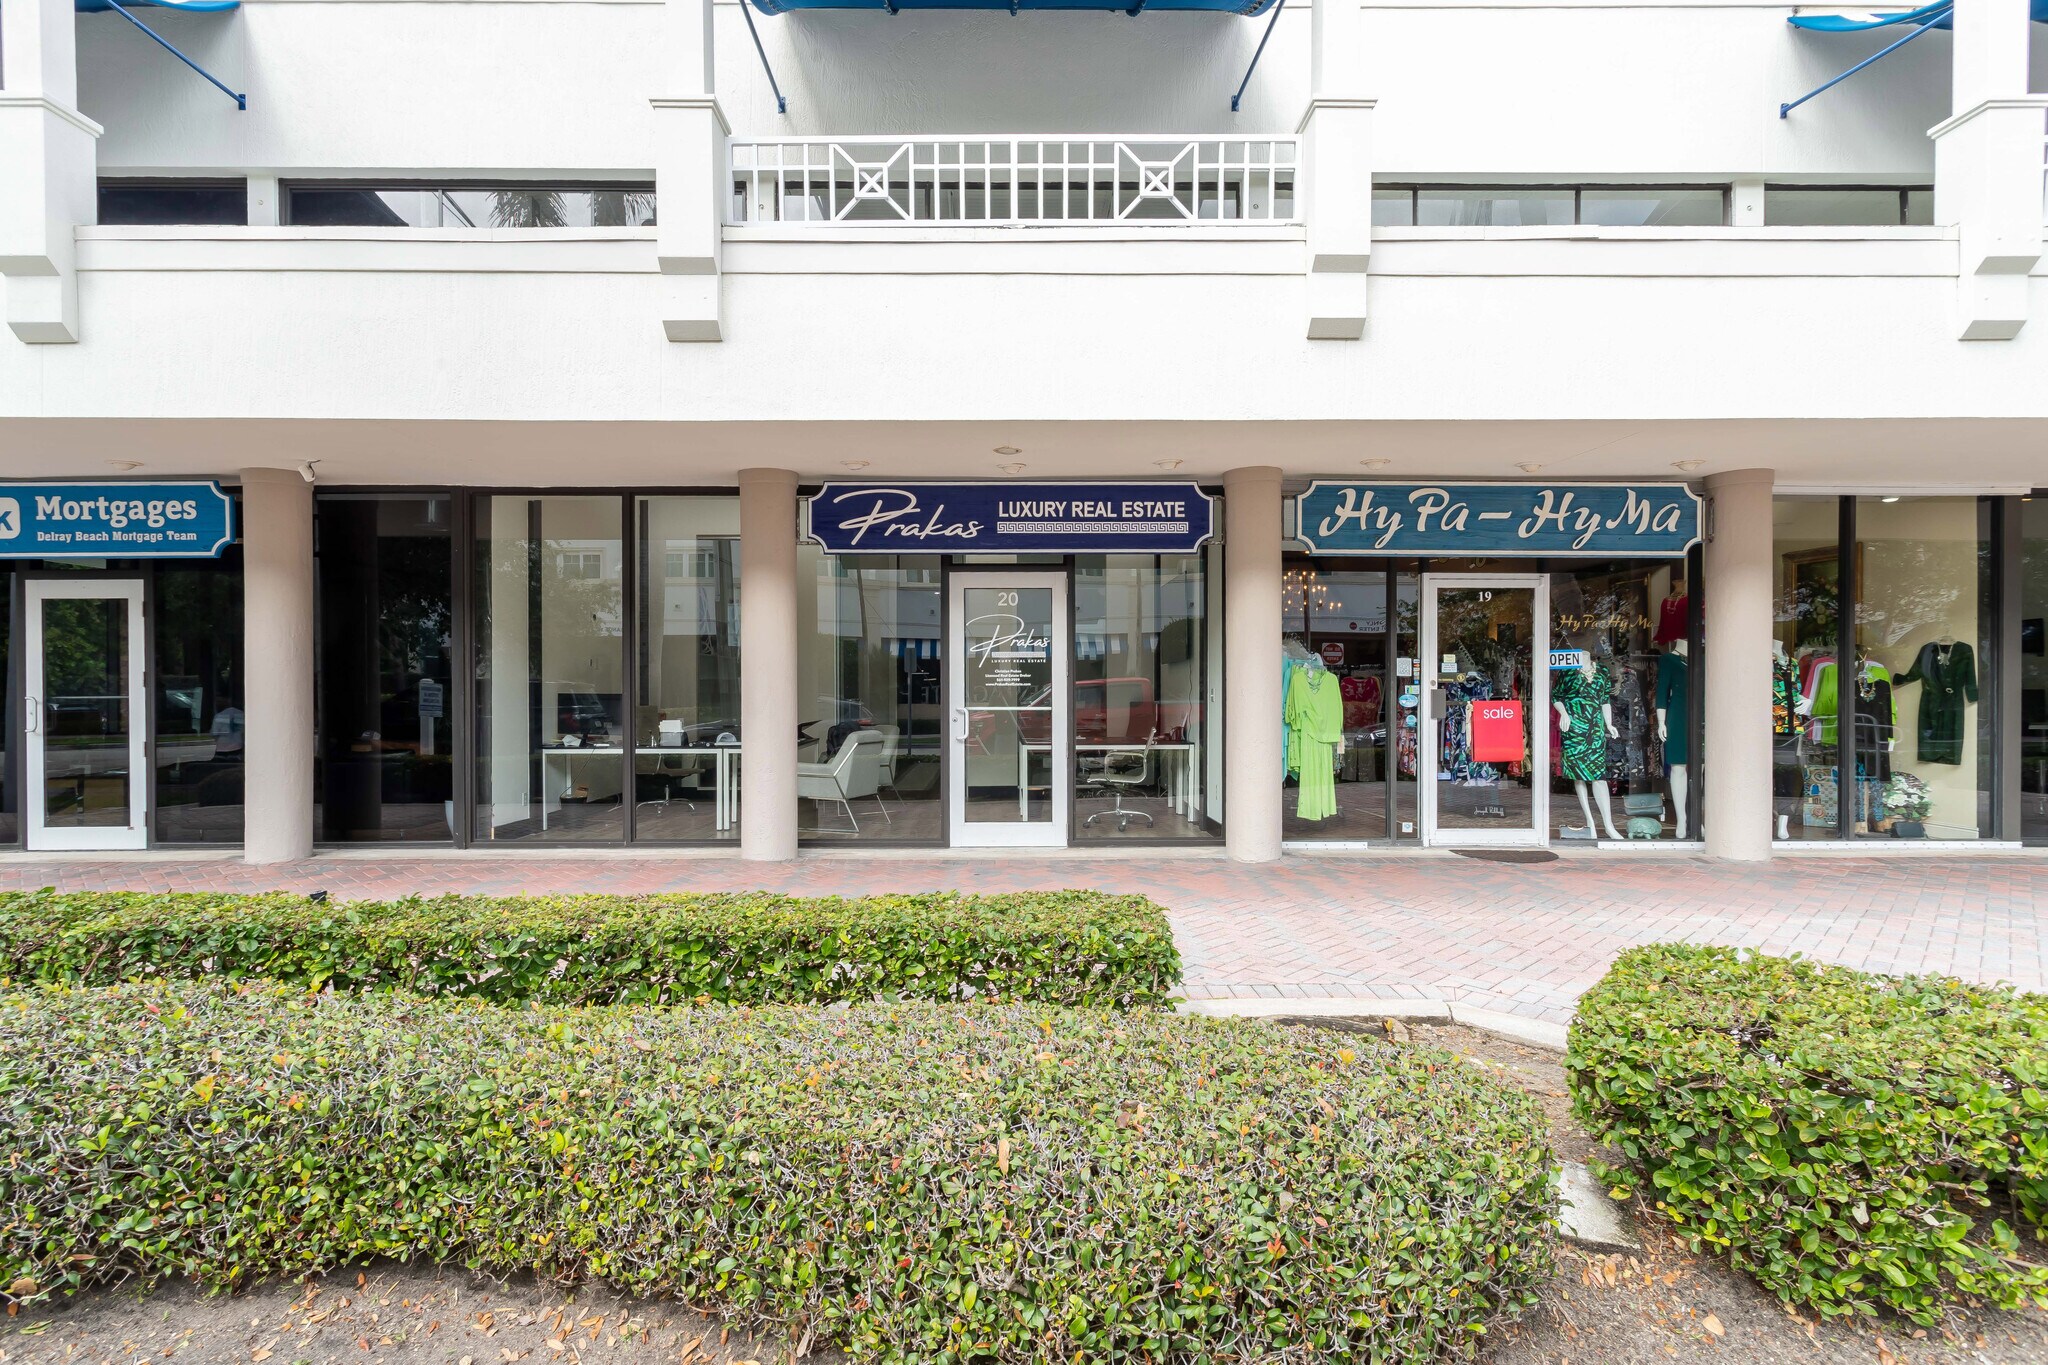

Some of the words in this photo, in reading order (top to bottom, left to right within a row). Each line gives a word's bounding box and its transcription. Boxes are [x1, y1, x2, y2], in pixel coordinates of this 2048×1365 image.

[35, 496, 198, 528] Mortgages
[833, 488, 985, 546] Prakas
[998, 501, 1068, 518] LUXURY
[1072, 501, 1118, 518] REAL
[1121, 501, 1186, 518] ESTATE
[37, 531, 72, 543] Delray
[75, 531, 109, 542] Beach
[112, 531, 163, 543] Mortgage
[166, 531, 197, 541] Team
[997, 591, 1019, 607] 20
[1478, 591, 1492, 602] 19
[965, 613, 1050, 668] Prakas
[1550, 653, 1580, 666] OPEN
[1483, 706, 1515, 719] sale
